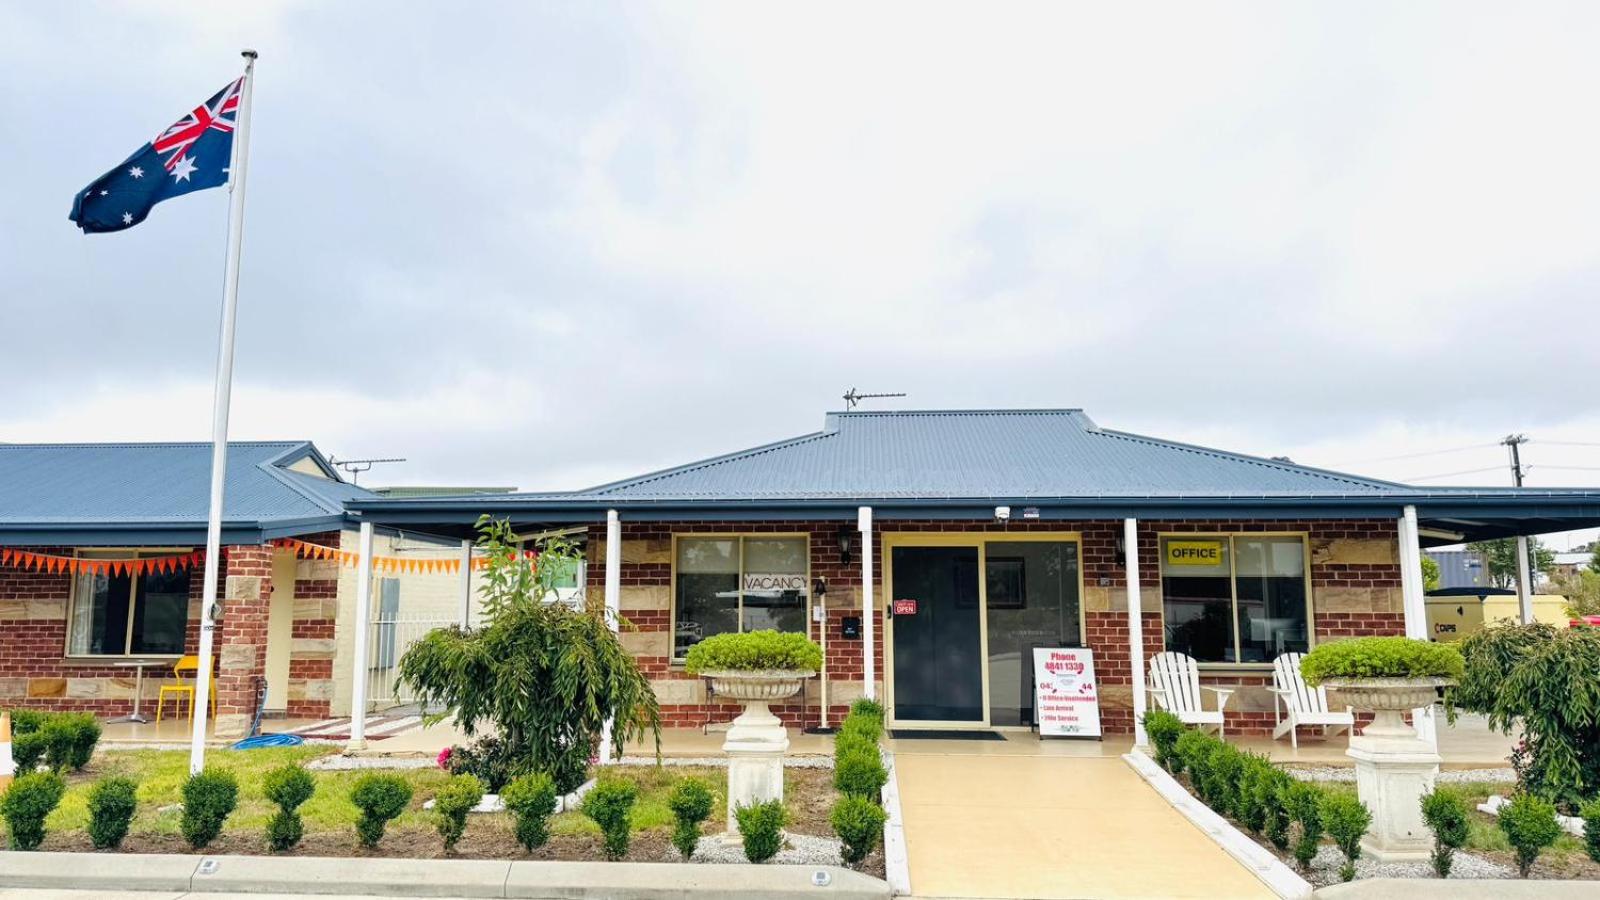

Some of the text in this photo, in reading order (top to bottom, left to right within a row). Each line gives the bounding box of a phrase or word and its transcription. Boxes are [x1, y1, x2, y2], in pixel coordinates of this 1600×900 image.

[1171, 548, 1216, 558] OFFICE
[744, 577, 808, 589] VACANCY
[896, 605, 914, 613] OPEN
[1050, 652, 1076, 661] Phone
